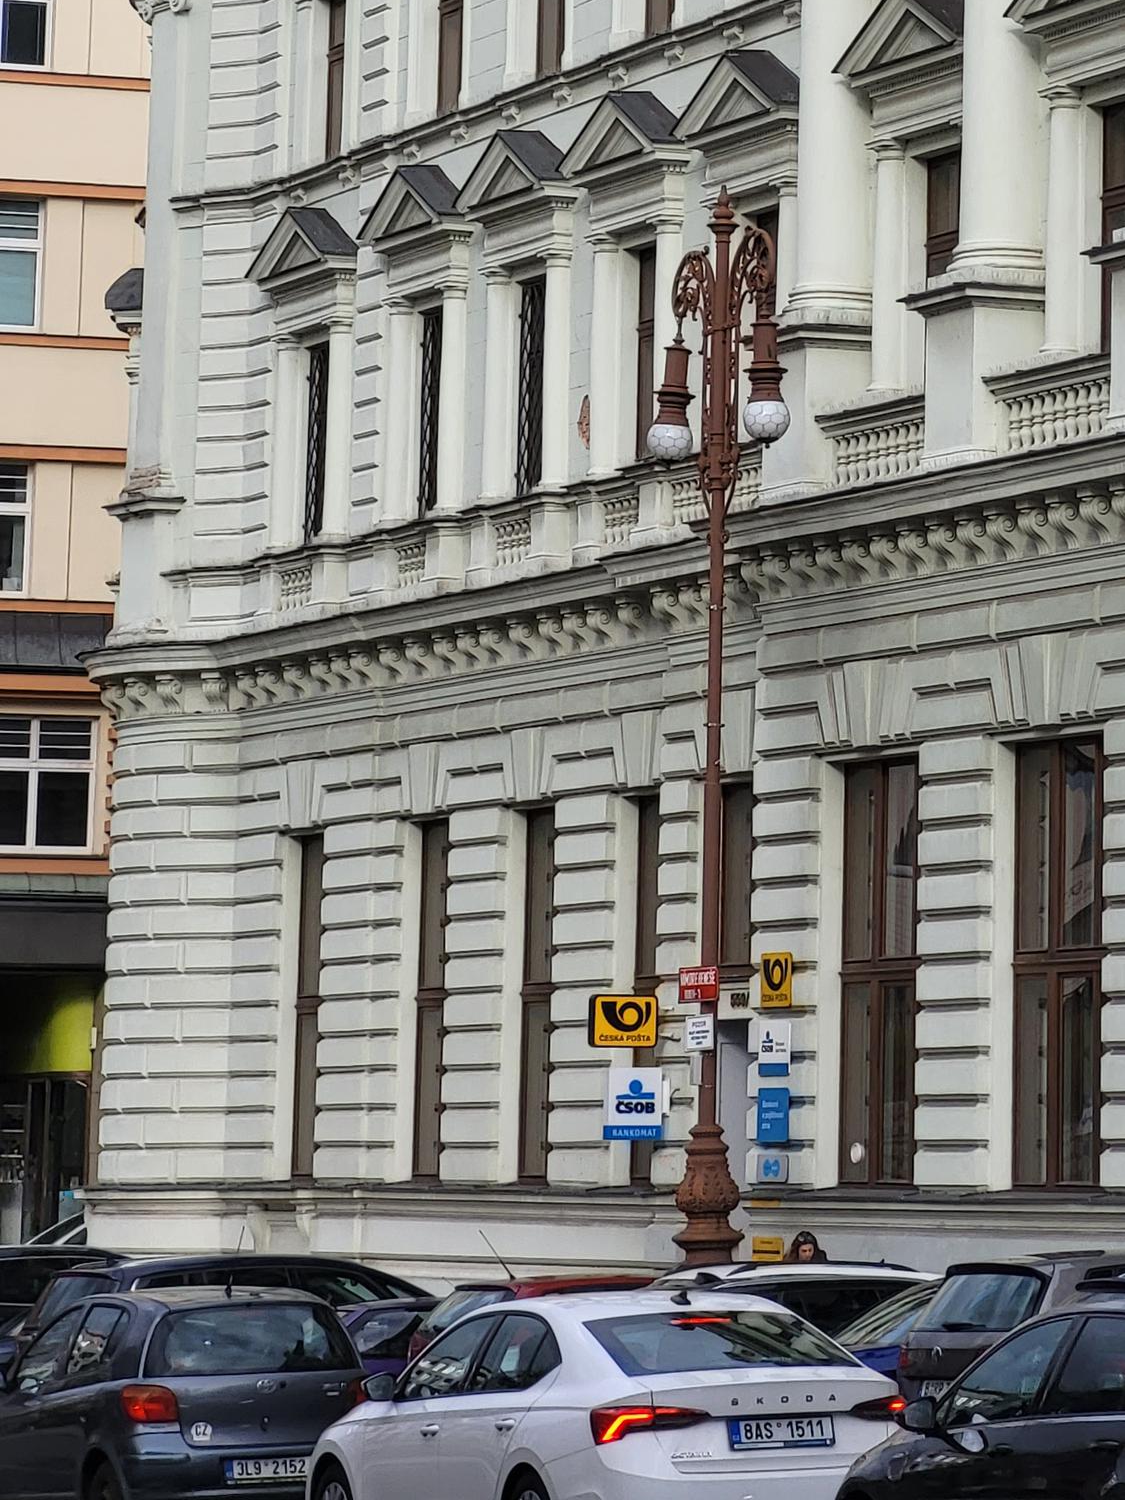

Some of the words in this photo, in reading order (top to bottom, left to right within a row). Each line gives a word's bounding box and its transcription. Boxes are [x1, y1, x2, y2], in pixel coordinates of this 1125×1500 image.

[599, 1034, 625, 1042] ČESKÁ
[625, 1033, 651, 1042] POŠTA
[615, 1100, 656, 1115] ČSOB
[611, 1128, 657, 1138] BANKOMAT
[194, 1424, 209, 1437] CZ
[743, 1421, 774, 1441] 8AS
[786, 1419, 826, 1439] 1511
[236, 1460, 262, 1477] 3L9
[272, 1458, 306, 1476] 2152
